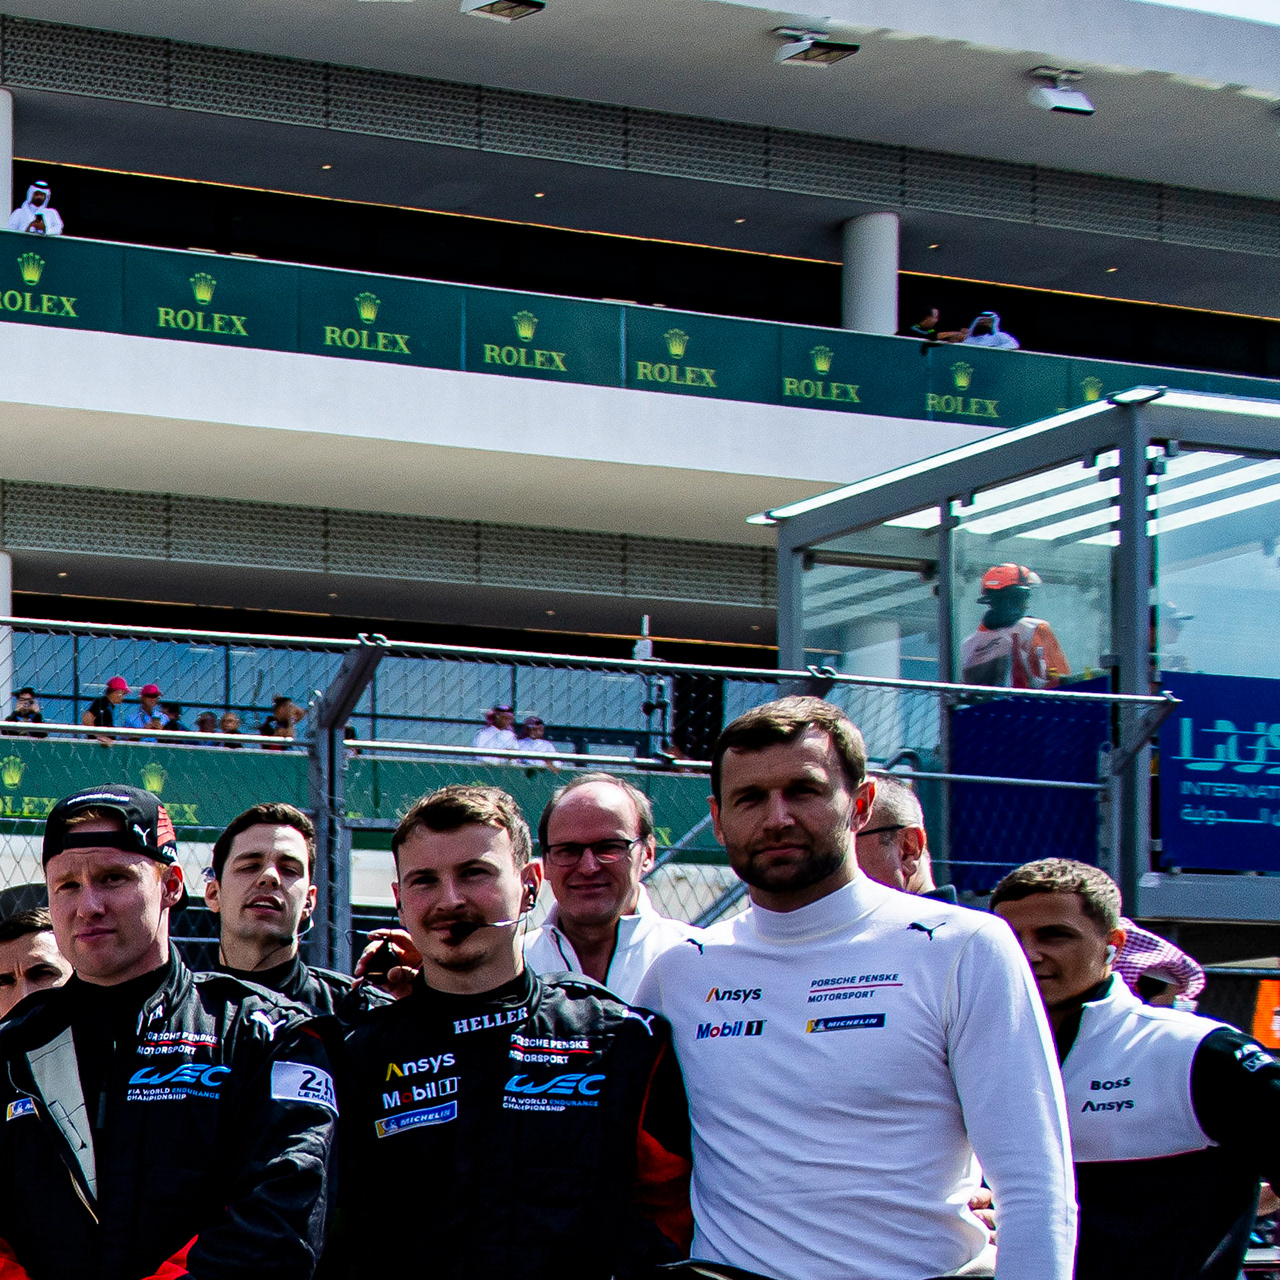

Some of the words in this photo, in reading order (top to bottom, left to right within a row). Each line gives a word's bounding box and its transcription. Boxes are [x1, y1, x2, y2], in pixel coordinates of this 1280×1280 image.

[157, 307, 248, 336] ROLEX
[324, 326, 411, 354] ROLEX
[483, 343, 567, 372] ROLEX
[636, 361, 717, 388] ROLEX
[783, 377, 860, 402] ROLEX
[925, 392, 1000, 418] ROLEX
[810, 974, 857, 989] PORSCHE
[858, 973, 899, 984] PENSKE
[705, 987, 763, 1004] Ansys
[807, 989, 876, 1004] MOTORSPORT
[453, 1006, 529, 1034] HELLER
[696, 1019, 744, 1041] Mobil
[826, 1016, 879, 1028] MICHELIN
[550, 1038, 590, 1051] PENSKE
[129, 1063, 232, 1087] WEC
[385, 1053, 456, 1081] Ansys
[382, 1082, 438, 1110] Mobil
[504, 1073, 607, 1096] WEC
[1081, 1098, 1136, 1113] Ansys
[399, 1108, 452, 1128] MICHELIN
